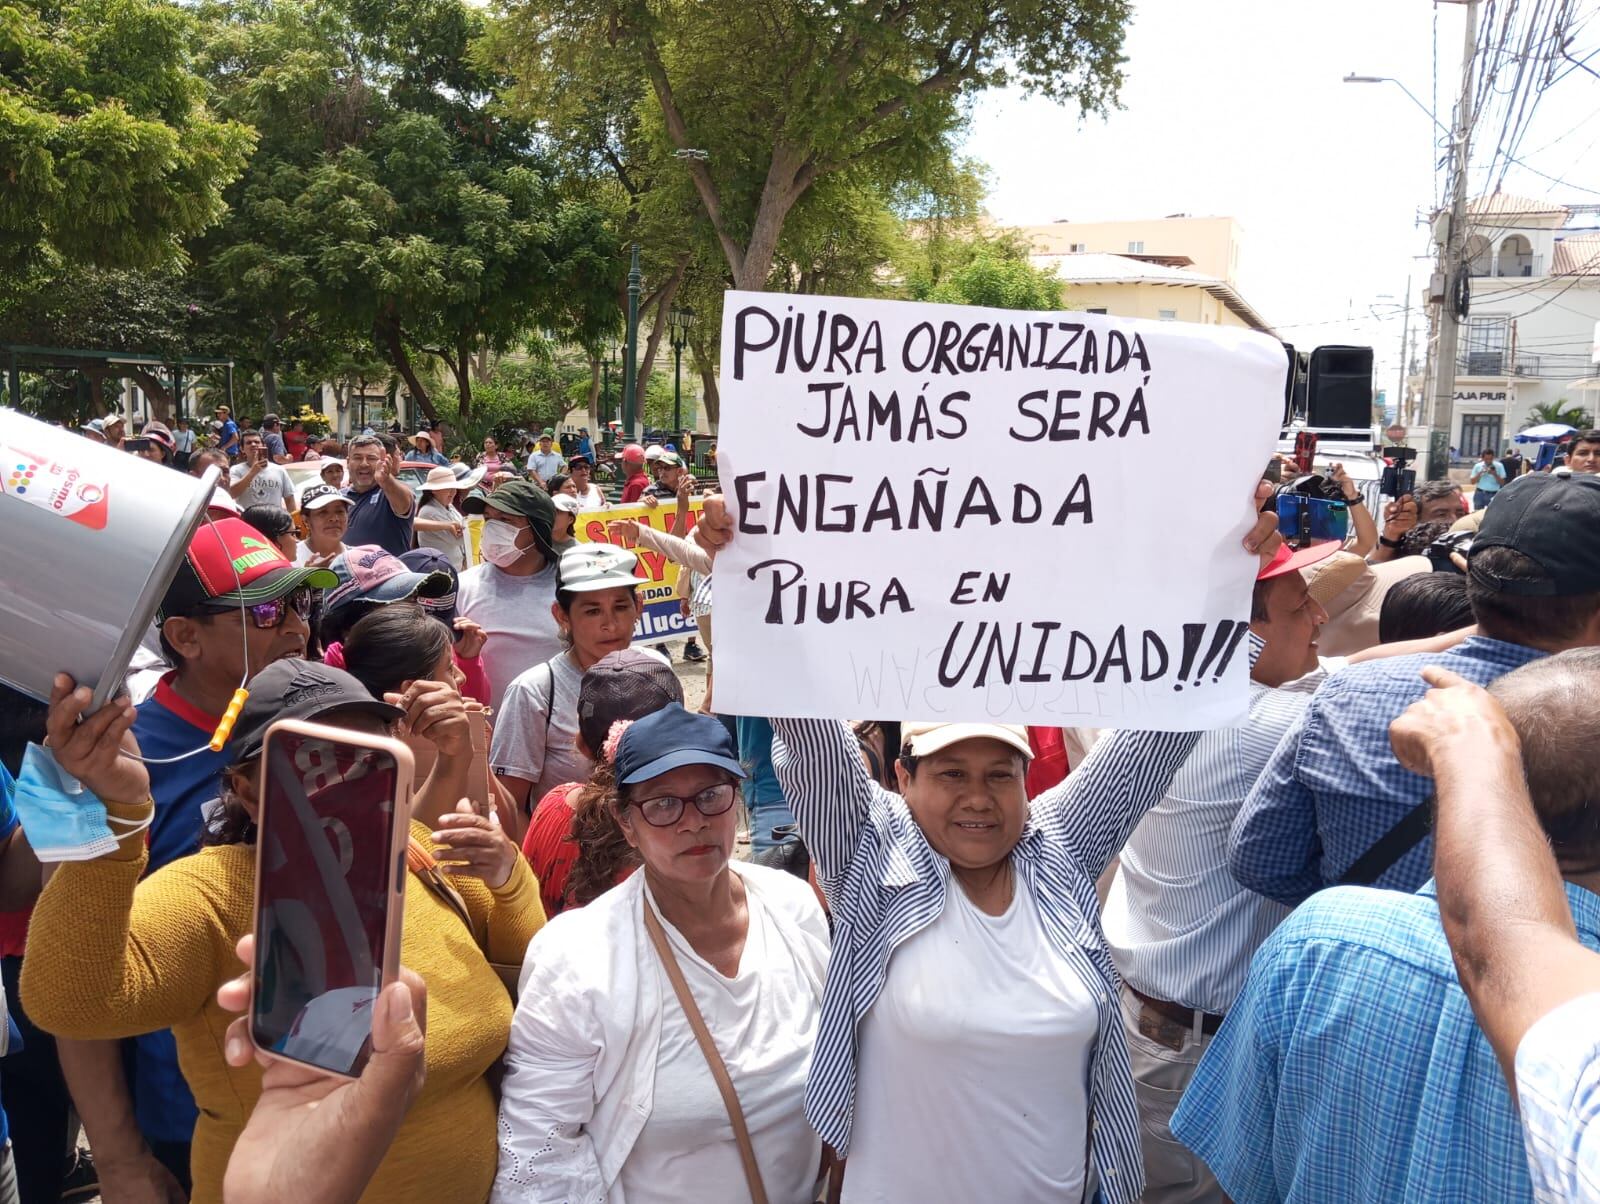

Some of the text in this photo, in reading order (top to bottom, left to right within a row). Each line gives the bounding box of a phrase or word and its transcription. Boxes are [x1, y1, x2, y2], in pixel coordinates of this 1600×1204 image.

[903, 321, 1150, 375] ORGANIZADA
[797, 376, 1150, 443] JAMÁS SERÁ
[1480, 391, 1514, 400] PIUR
[249, 479, 280, 489] NADA
[303, 485, 340, 502] SPOR
[734, 468, 1093, 534] ENGAÑADA
[950, 572, 1010, 604] EN
[939, 620, 1248, 691] UNIDAD!!!
